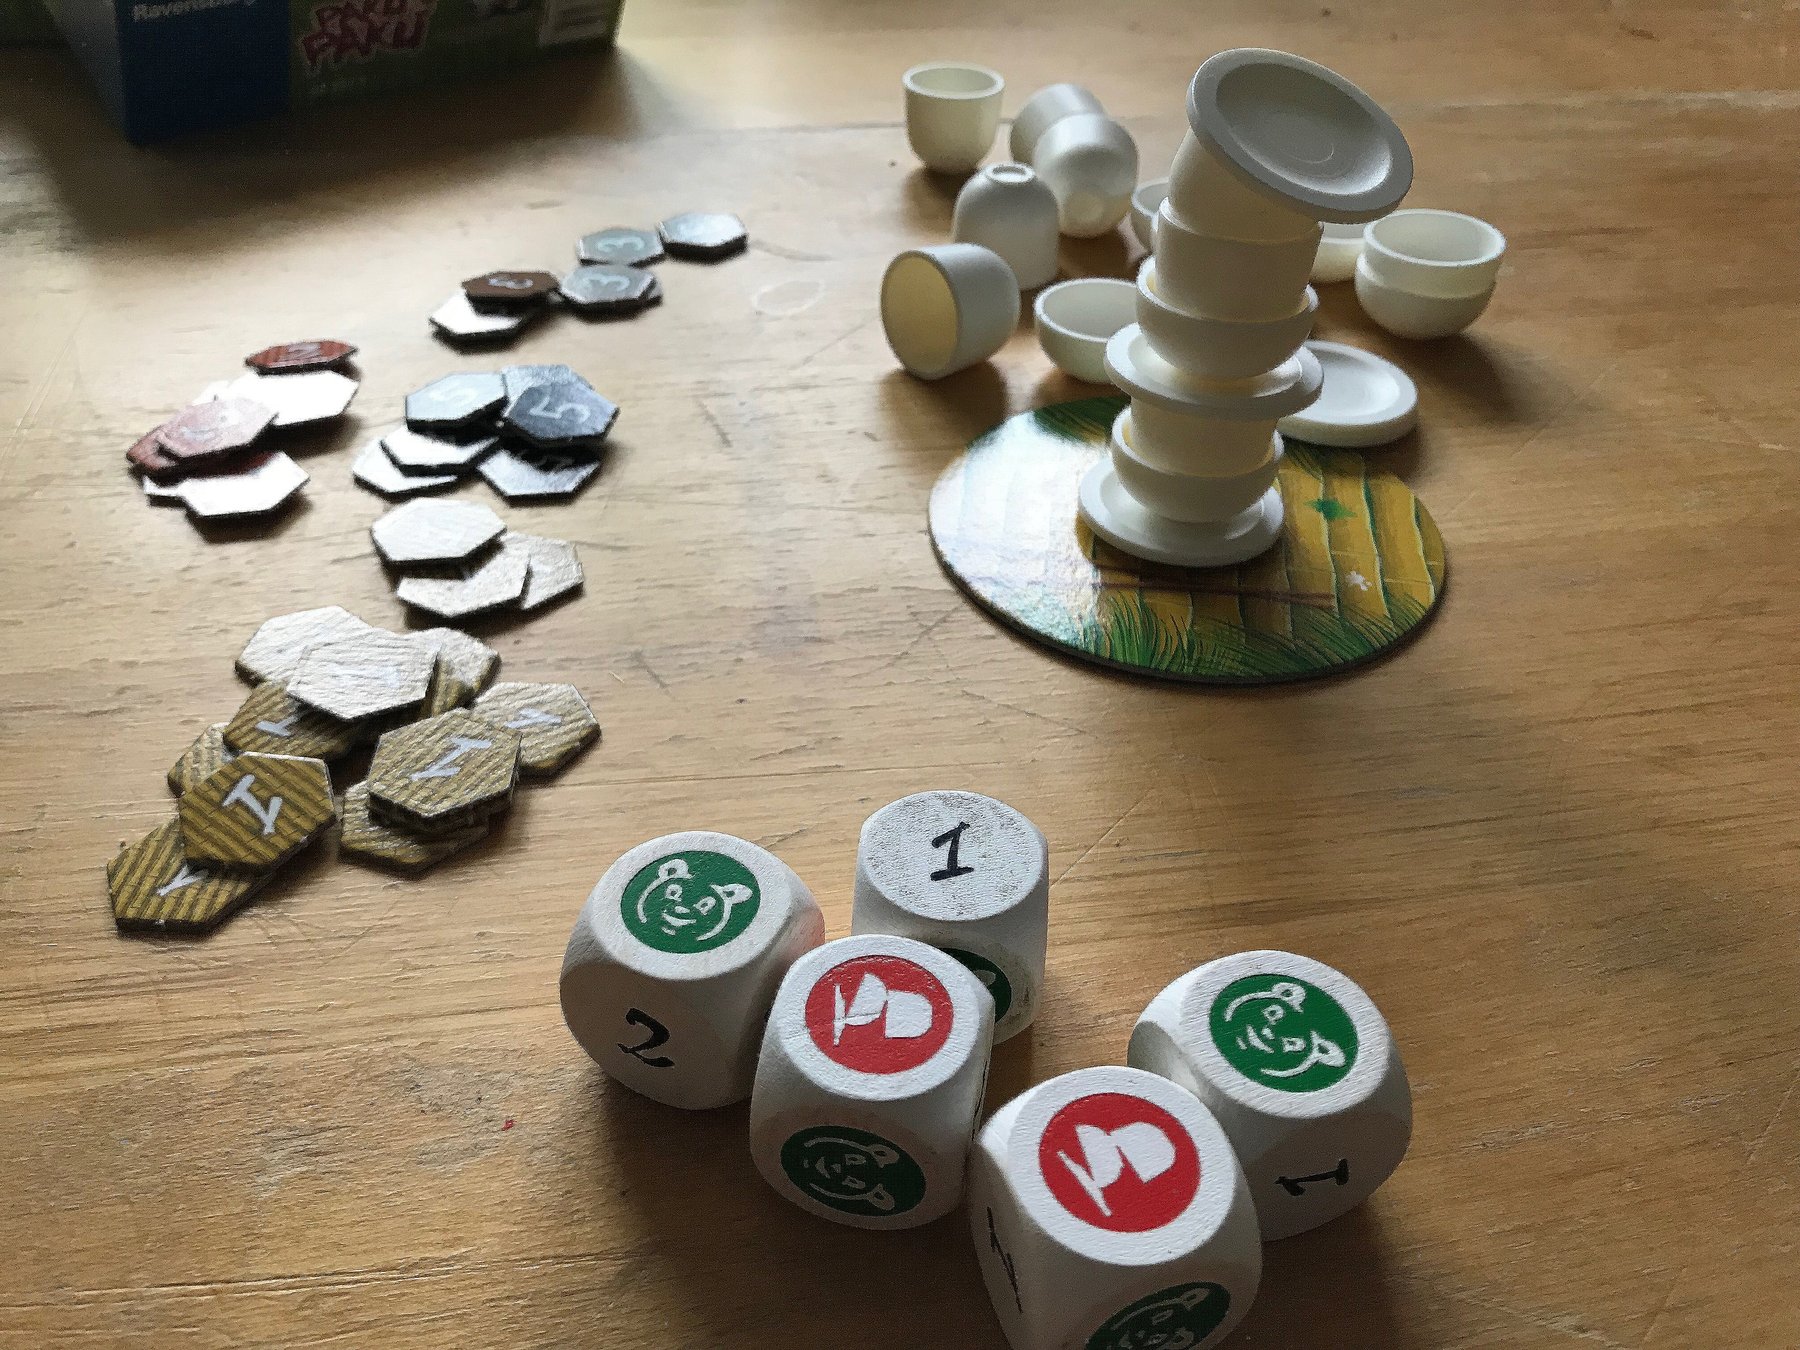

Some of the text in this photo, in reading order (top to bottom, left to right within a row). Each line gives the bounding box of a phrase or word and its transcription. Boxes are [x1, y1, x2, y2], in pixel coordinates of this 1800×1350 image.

[529, 396, 591, 423] 5
[410, 737, 492, 781] 1
[223, 774, 283, 835] 1
[930, 821, 974, 882] 1
[617, 1008, 676, 1068] 2
[1273, 1158, 1349, 1197] 1
